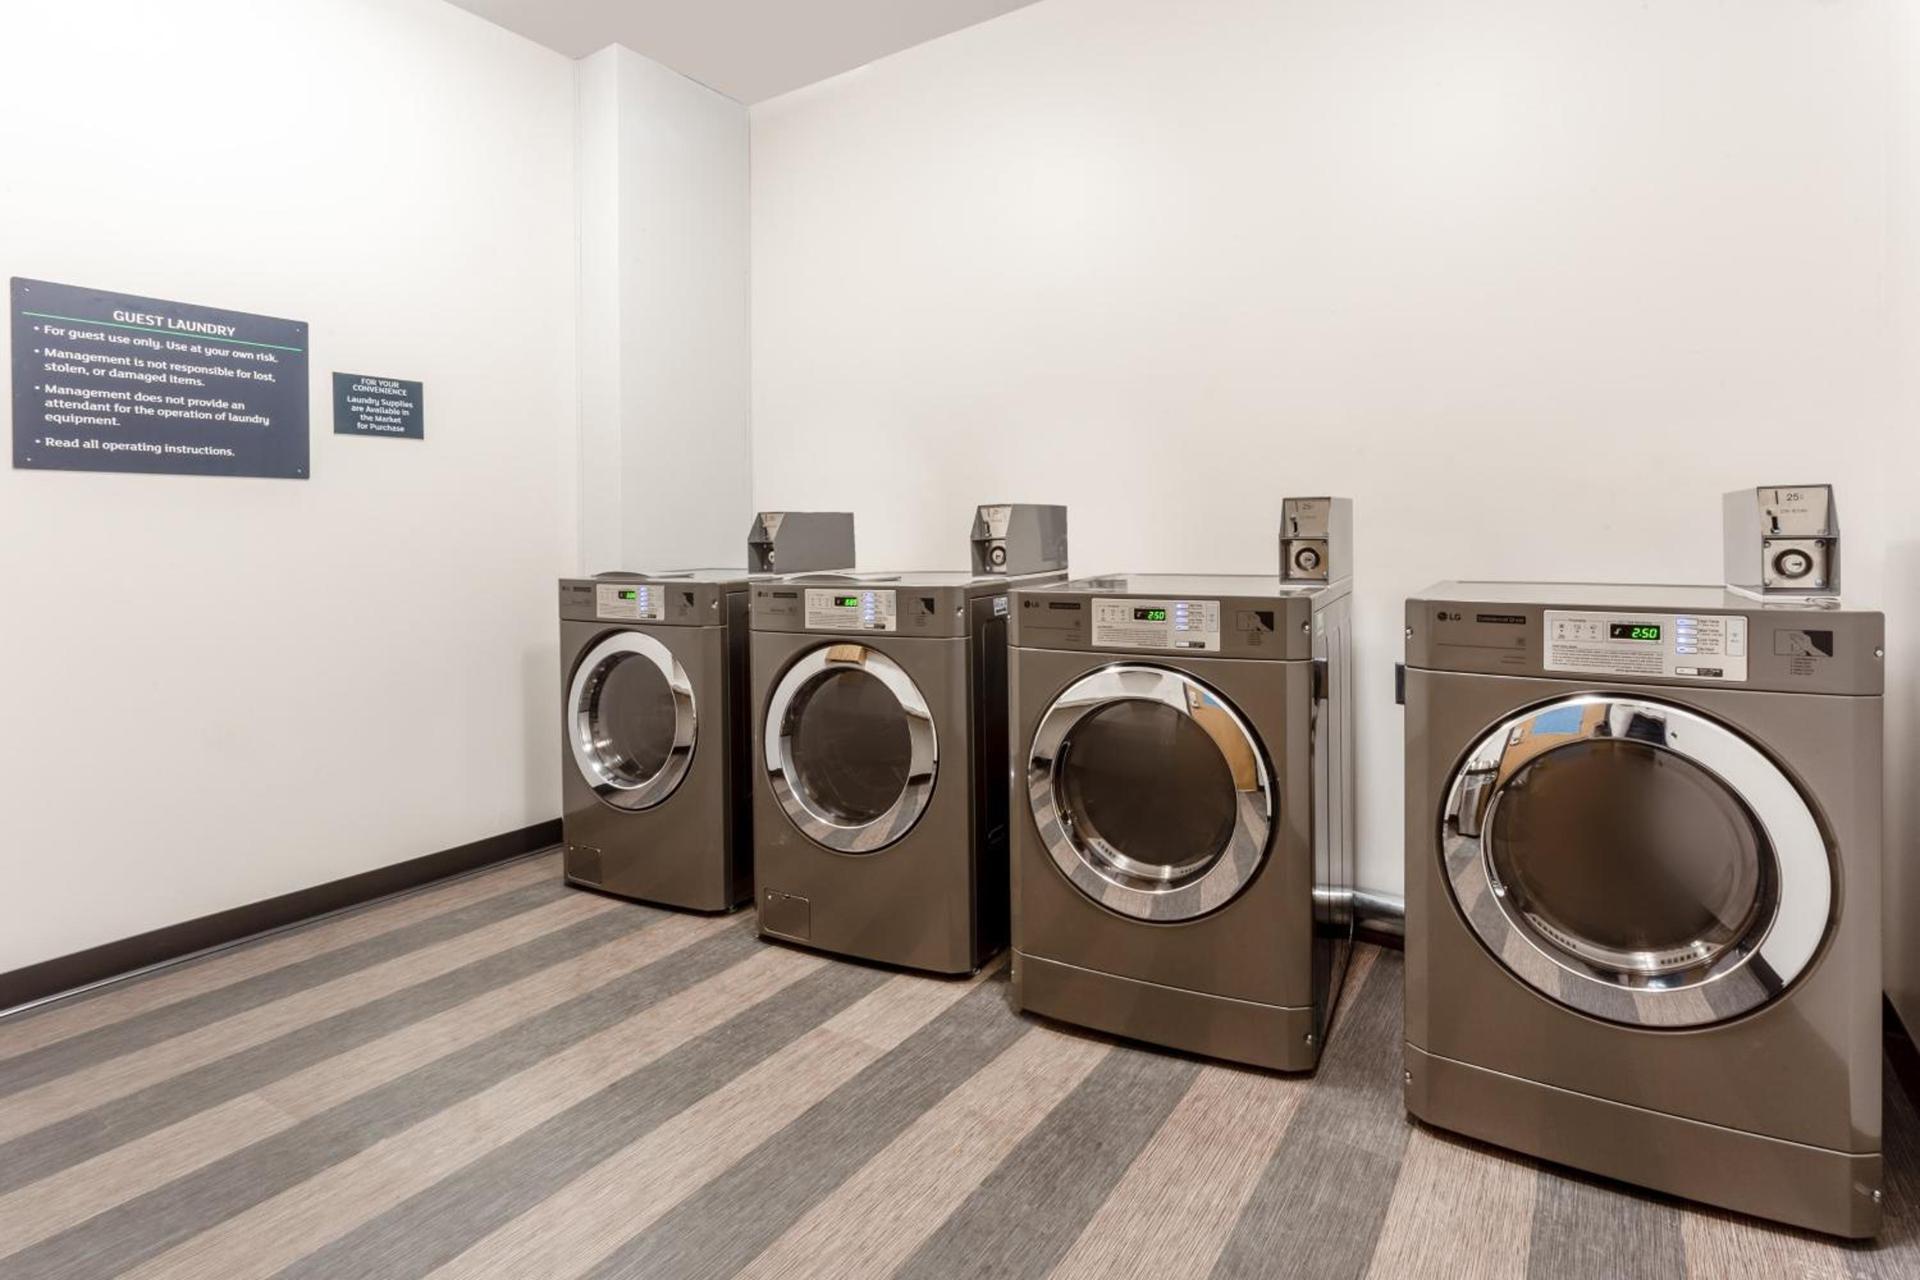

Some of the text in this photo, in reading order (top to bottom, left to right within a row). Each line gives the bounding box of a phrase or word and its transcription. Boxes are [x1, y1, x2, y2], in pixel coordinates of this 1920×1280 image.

[113, 310, 236, 336] GUEST LAUNDRY
[43, 324, 279, 363] For guest use only. Use at your own risk.
[44, 348, 276, 383] Management is not responsible for lost,
[44, 362, 205, 386] stolen, or damaged items.
[352, 384, 407, 396] CONVENIENCE
[361, 378, 399, 388] FOR YOUR
[44, 383, 245, 410] Management does not provide an
[347, 395, 413, 408] Laundry Supplies
[44, 398, 270, 426] attendant for the operation of laundry
[366, 406, 400, 415] Available
[44, 413, 120, 426] equipment.
[369, 423, 405, 432] Purchase
[375, 415, 401, 424] Market
[45, 437, 235, 456] Read all operating instructions.
